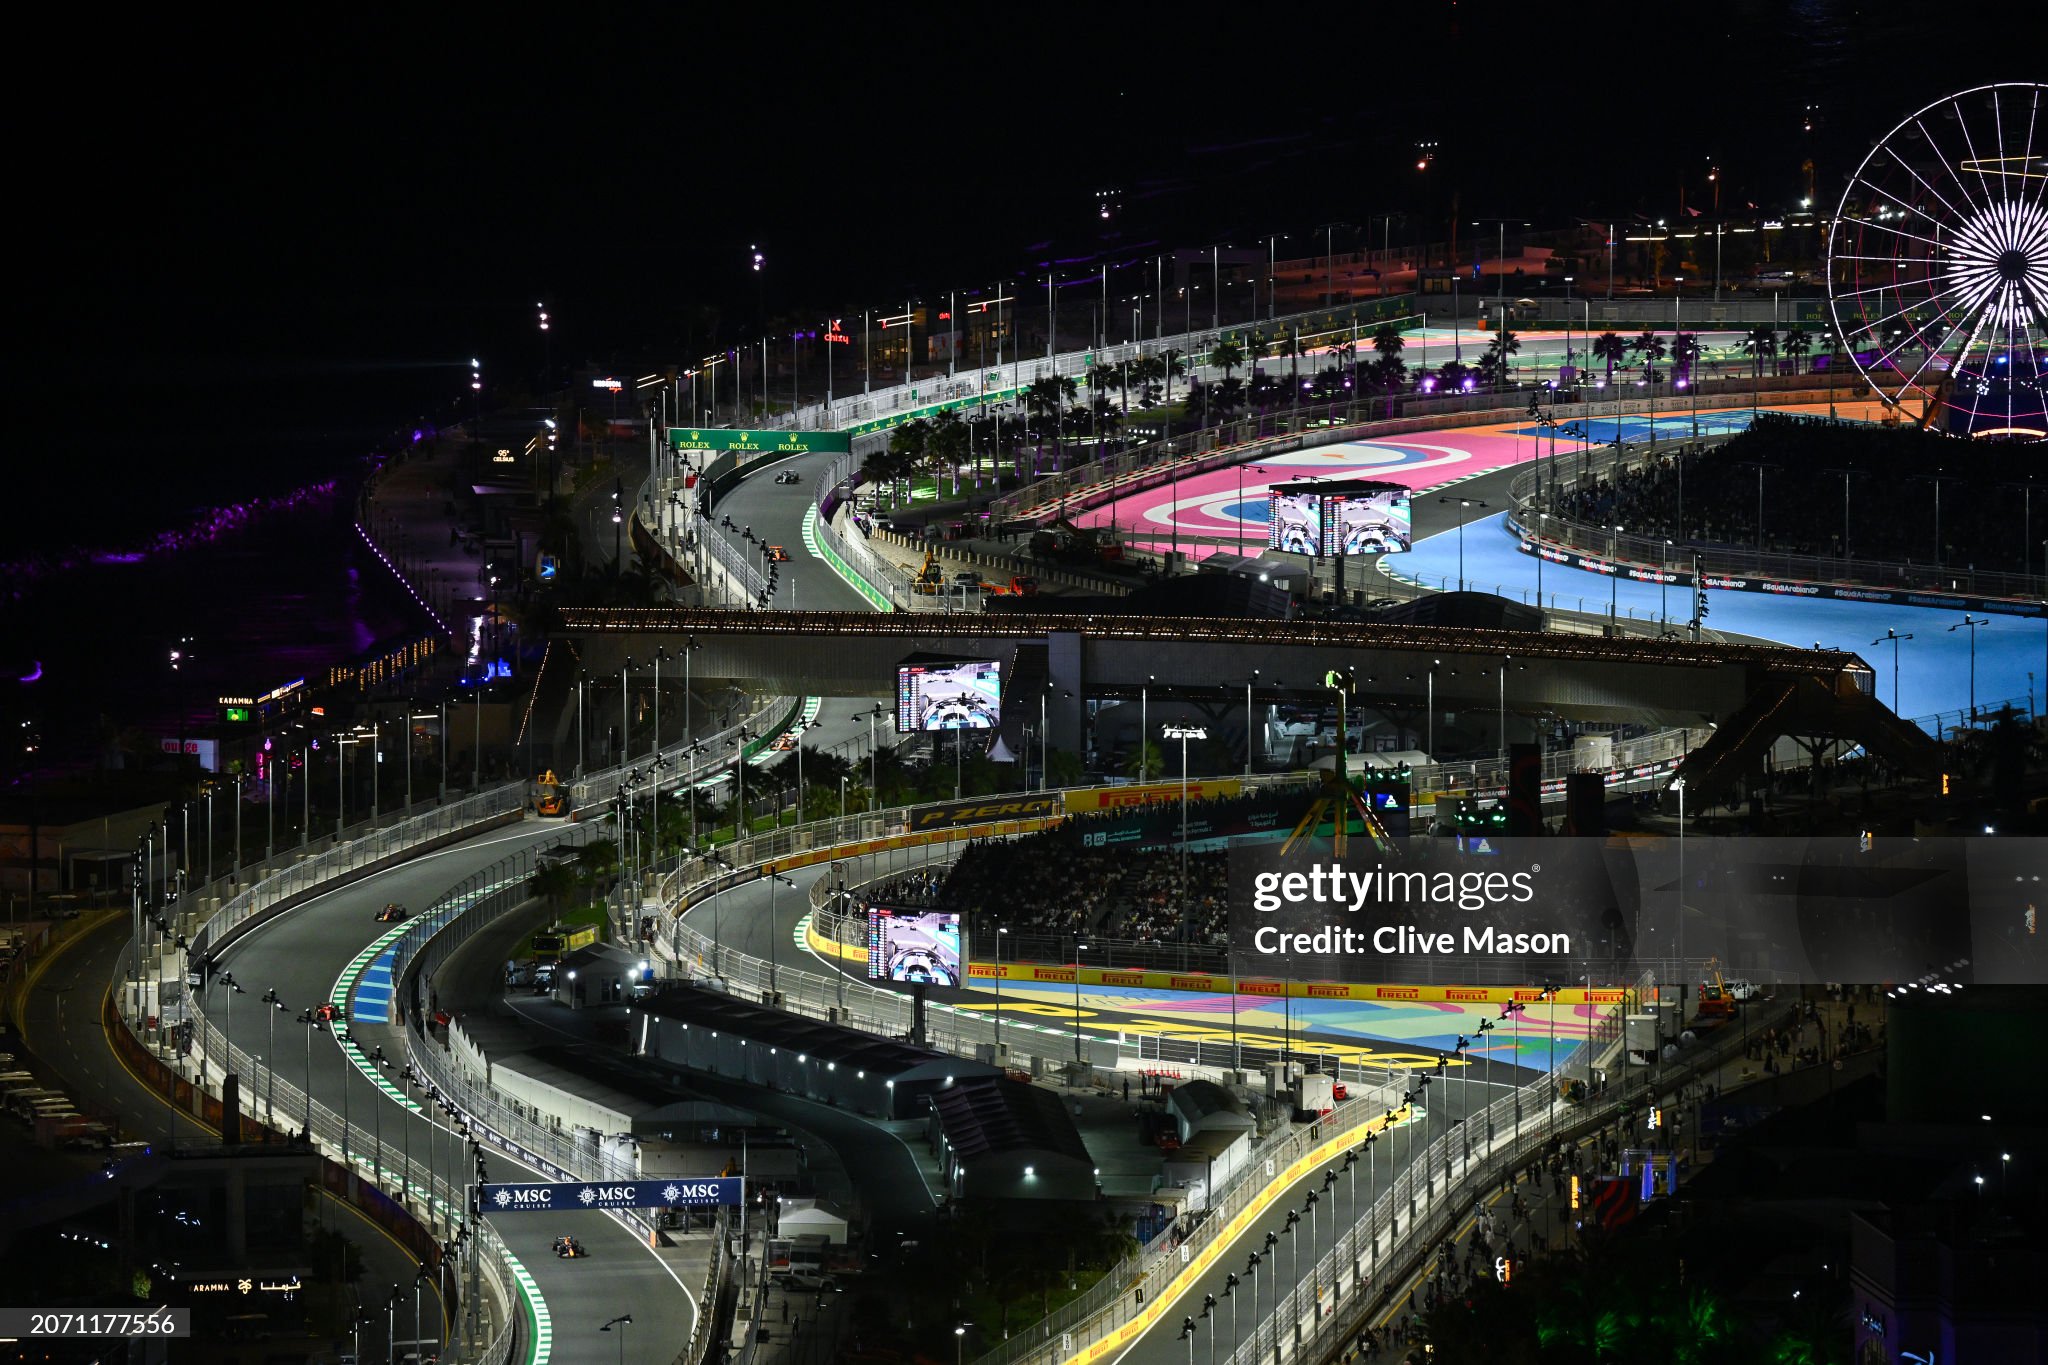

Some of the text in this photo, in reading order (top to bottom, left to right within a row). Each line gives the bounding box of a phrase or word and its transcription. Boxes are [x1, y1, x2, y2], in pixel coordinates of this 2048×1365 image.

[679, 441, 710, 449] ROLEX
[728, 442, 759, 450] ROLEX
[778, 443, 808, 451] ROLEX
[1762, 583, 1819, 594] #SaudiArabianGP
[1834, 589, 1891, 600] #SaudiArabianGP
[920, 801, 1050, 825] P ZERO
[853, 949, 868, 959] PIRE
[1034, 968, 1076, 981] PIRELLI
[1102, 972, 1144, 985] PIRELLI
[1170, 977, 1212, 990] PIRELLI
[1239, 982, 1281, 994] PIRELLI
[1307, 985, 1350, 997] PIRELLI
[1376, 987, 1419, 999] PIRELLI
[1445, 990, 1488, 1000] PIRELLI
[514, 1189, 552, 1203] MSC
[598, 1187, 636, 1201] MSC
[682, 1184, 719, 1198] MSC
